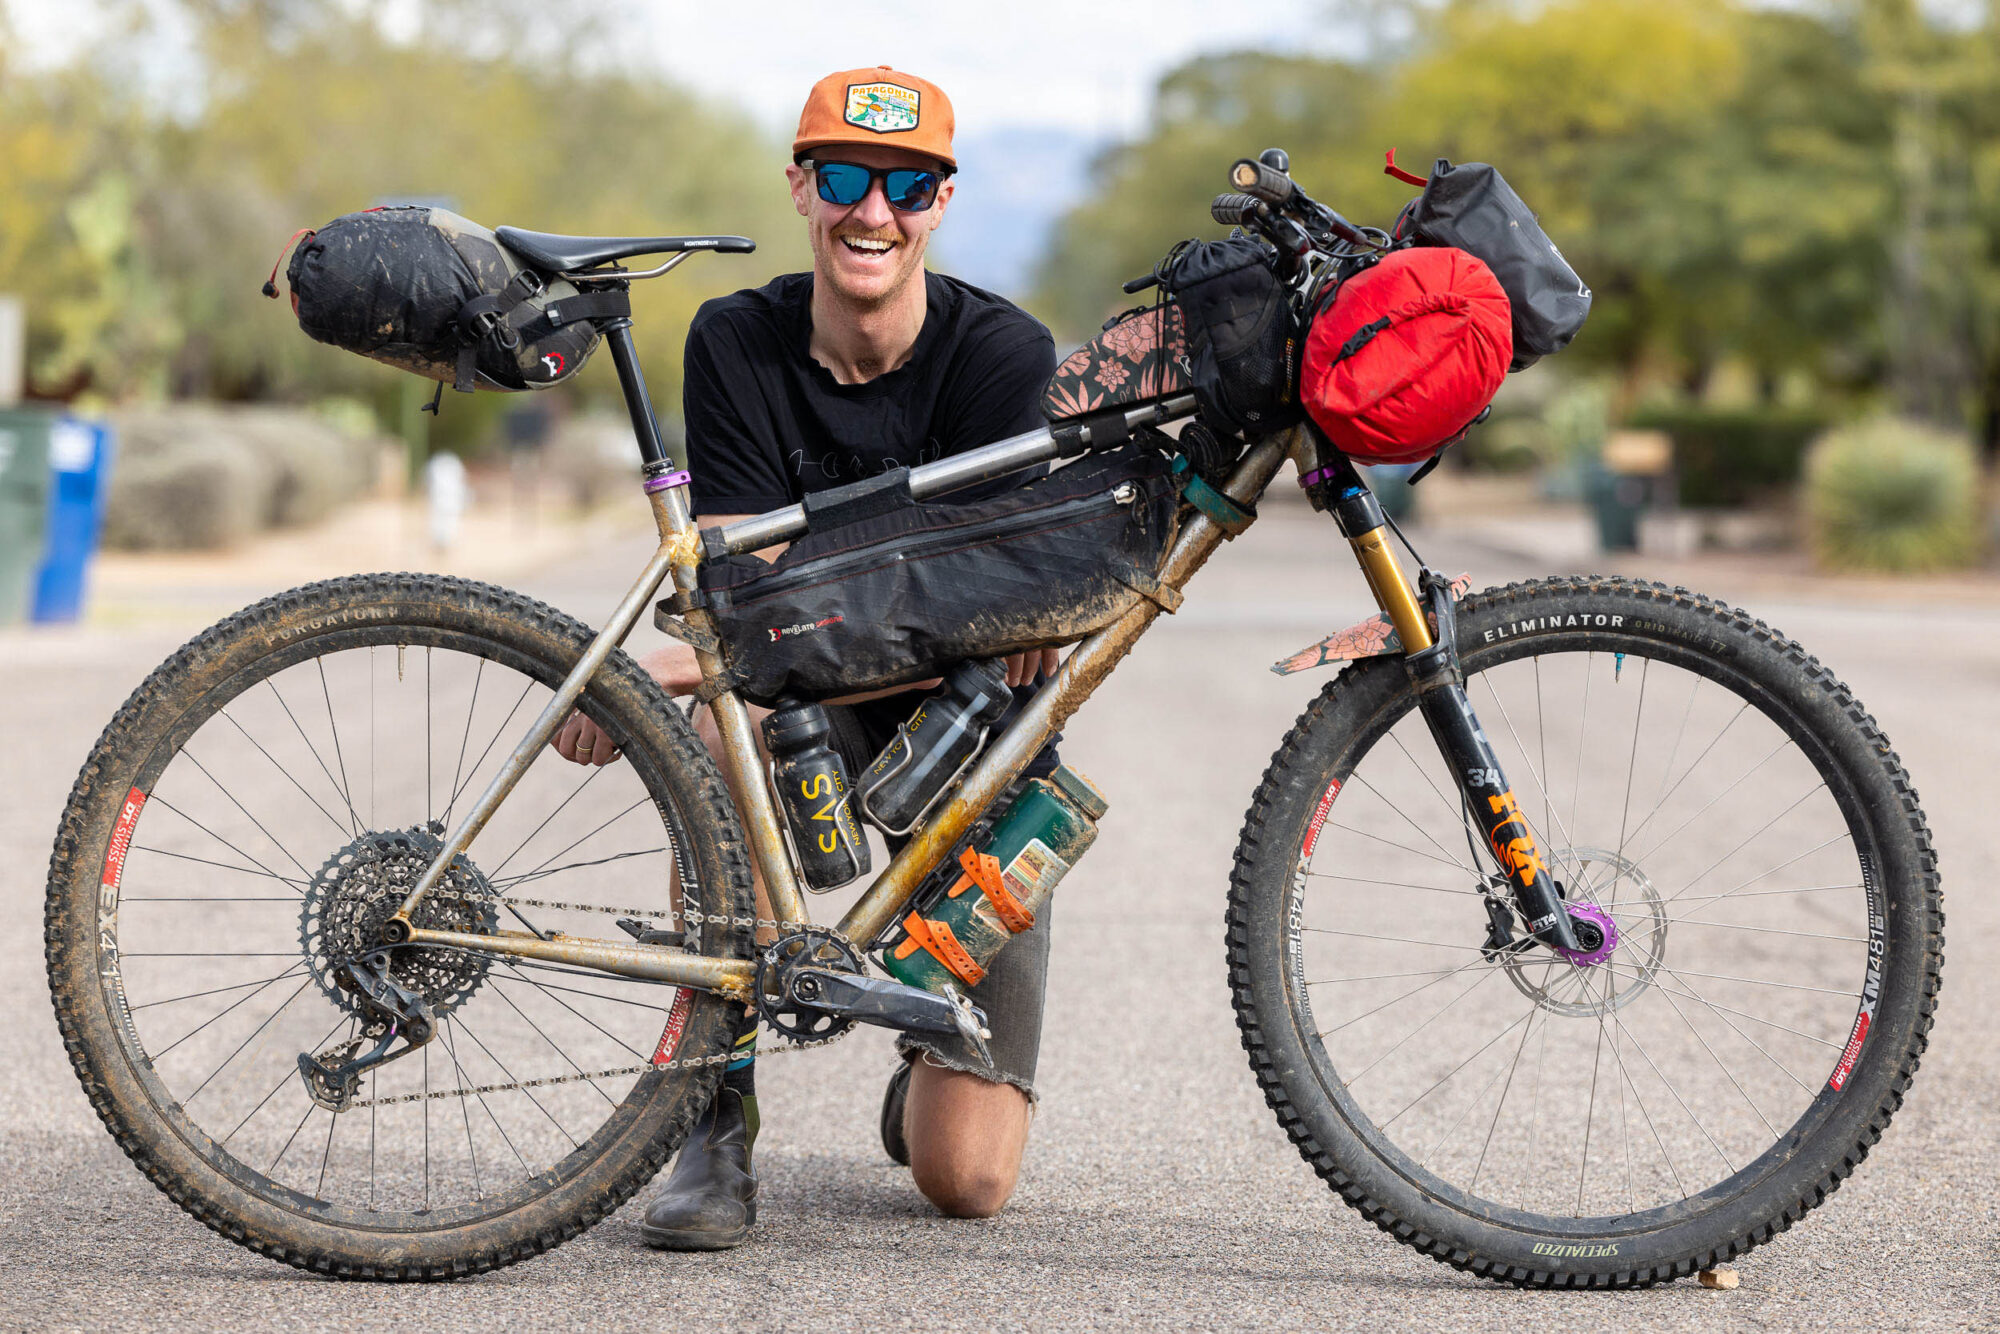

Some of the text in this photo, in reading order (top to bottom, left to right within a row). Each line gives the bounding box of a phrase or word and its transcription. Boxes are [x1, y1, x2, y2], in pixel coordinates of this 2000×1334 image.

[852, 86, 915, 101] PATAGONIA
[1484, 614, 1624, 643] ELIMINATOR
[910, 711, 928, 732] CITY
[831, 769, 844, 793] CITY
[1467, 768, 1501, 788] 34
[1310, 800, 1328, 831] SWISS
[108, 801, 136, 863] DT SWISS
[848, 821, 861, 847] NEW
[1844, 1039, 1863, 1069] SWISS
[1532, 1242, 1621, 1257] SPECIALIZED
